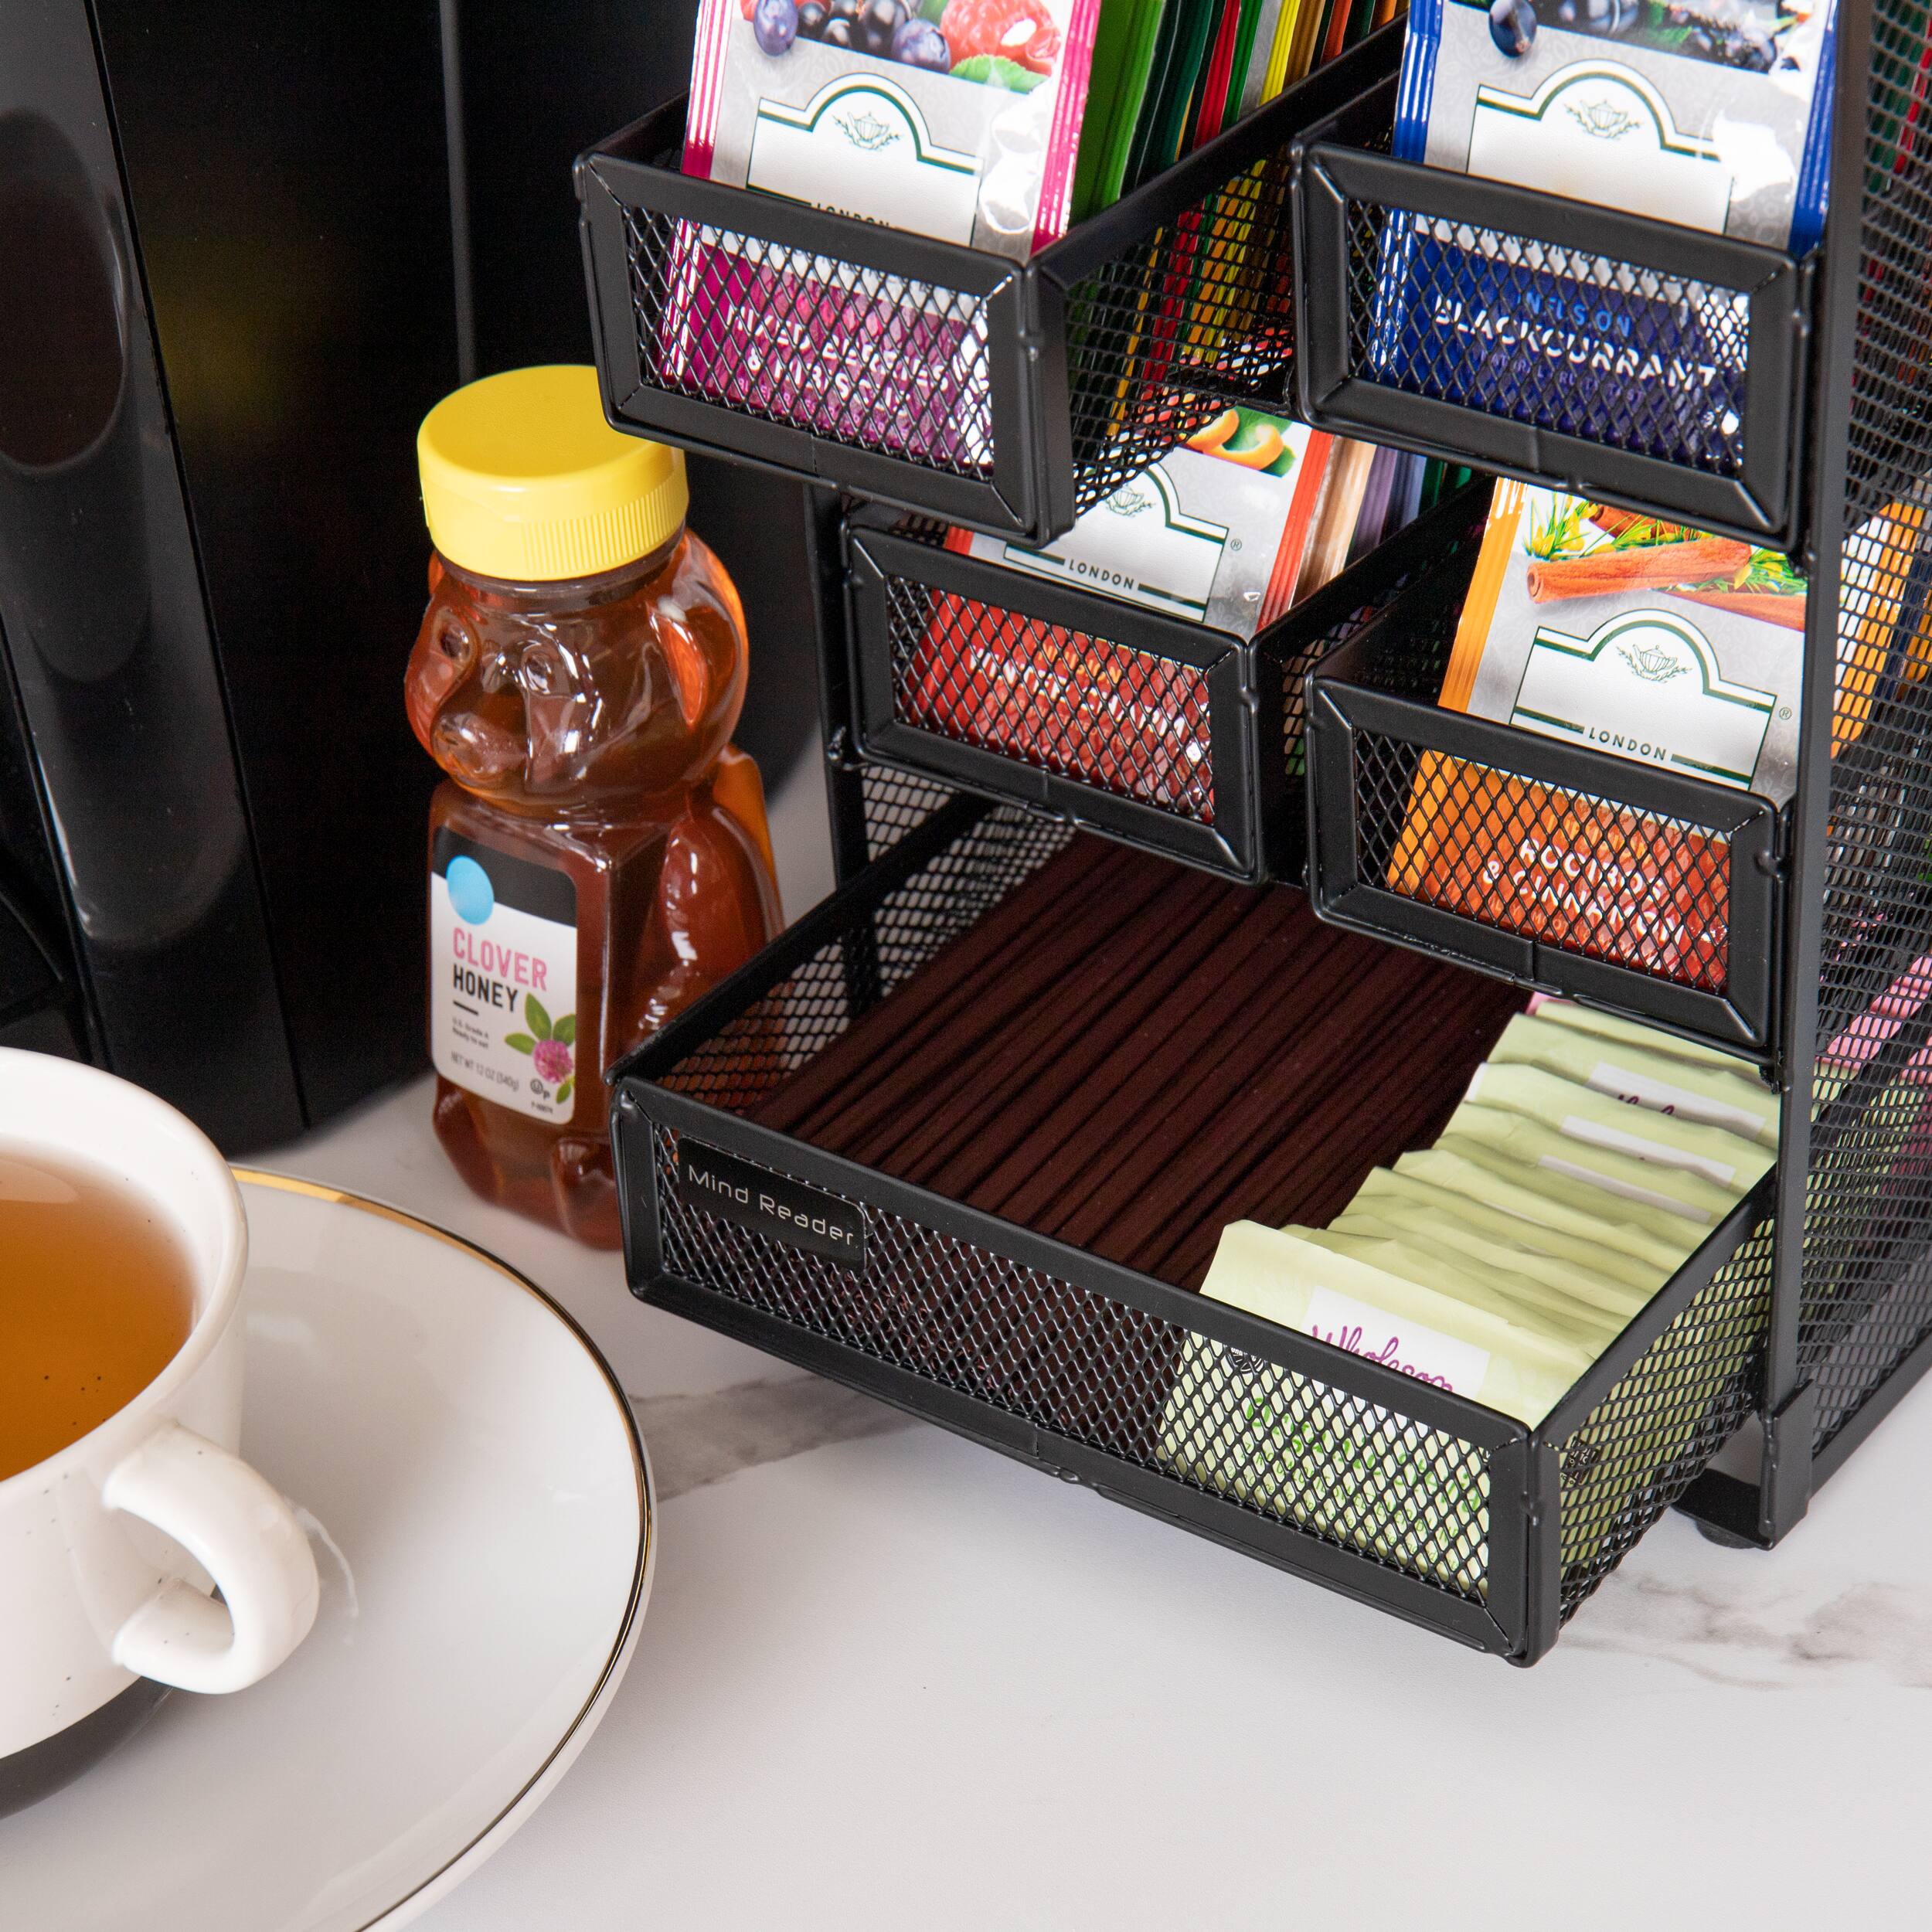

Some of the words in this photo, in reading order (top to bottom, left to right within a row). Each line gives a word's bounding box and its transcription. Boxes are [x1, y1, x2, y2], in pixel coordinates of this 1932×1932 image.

[1434, 294, 1717, 392] BLACKCURRANT
[1069, 558, 1135, 590] LONDON
[1588, 726, 1667, 761] LONDON
[1482, 860, 1500, 884] &
[453, 927, 548, 992] CLOVER
[452, 962, 519, 1013] HONEY
[688, 1164, 749, 1204] Mind
[759, 1192, 854, 1246] Reader
